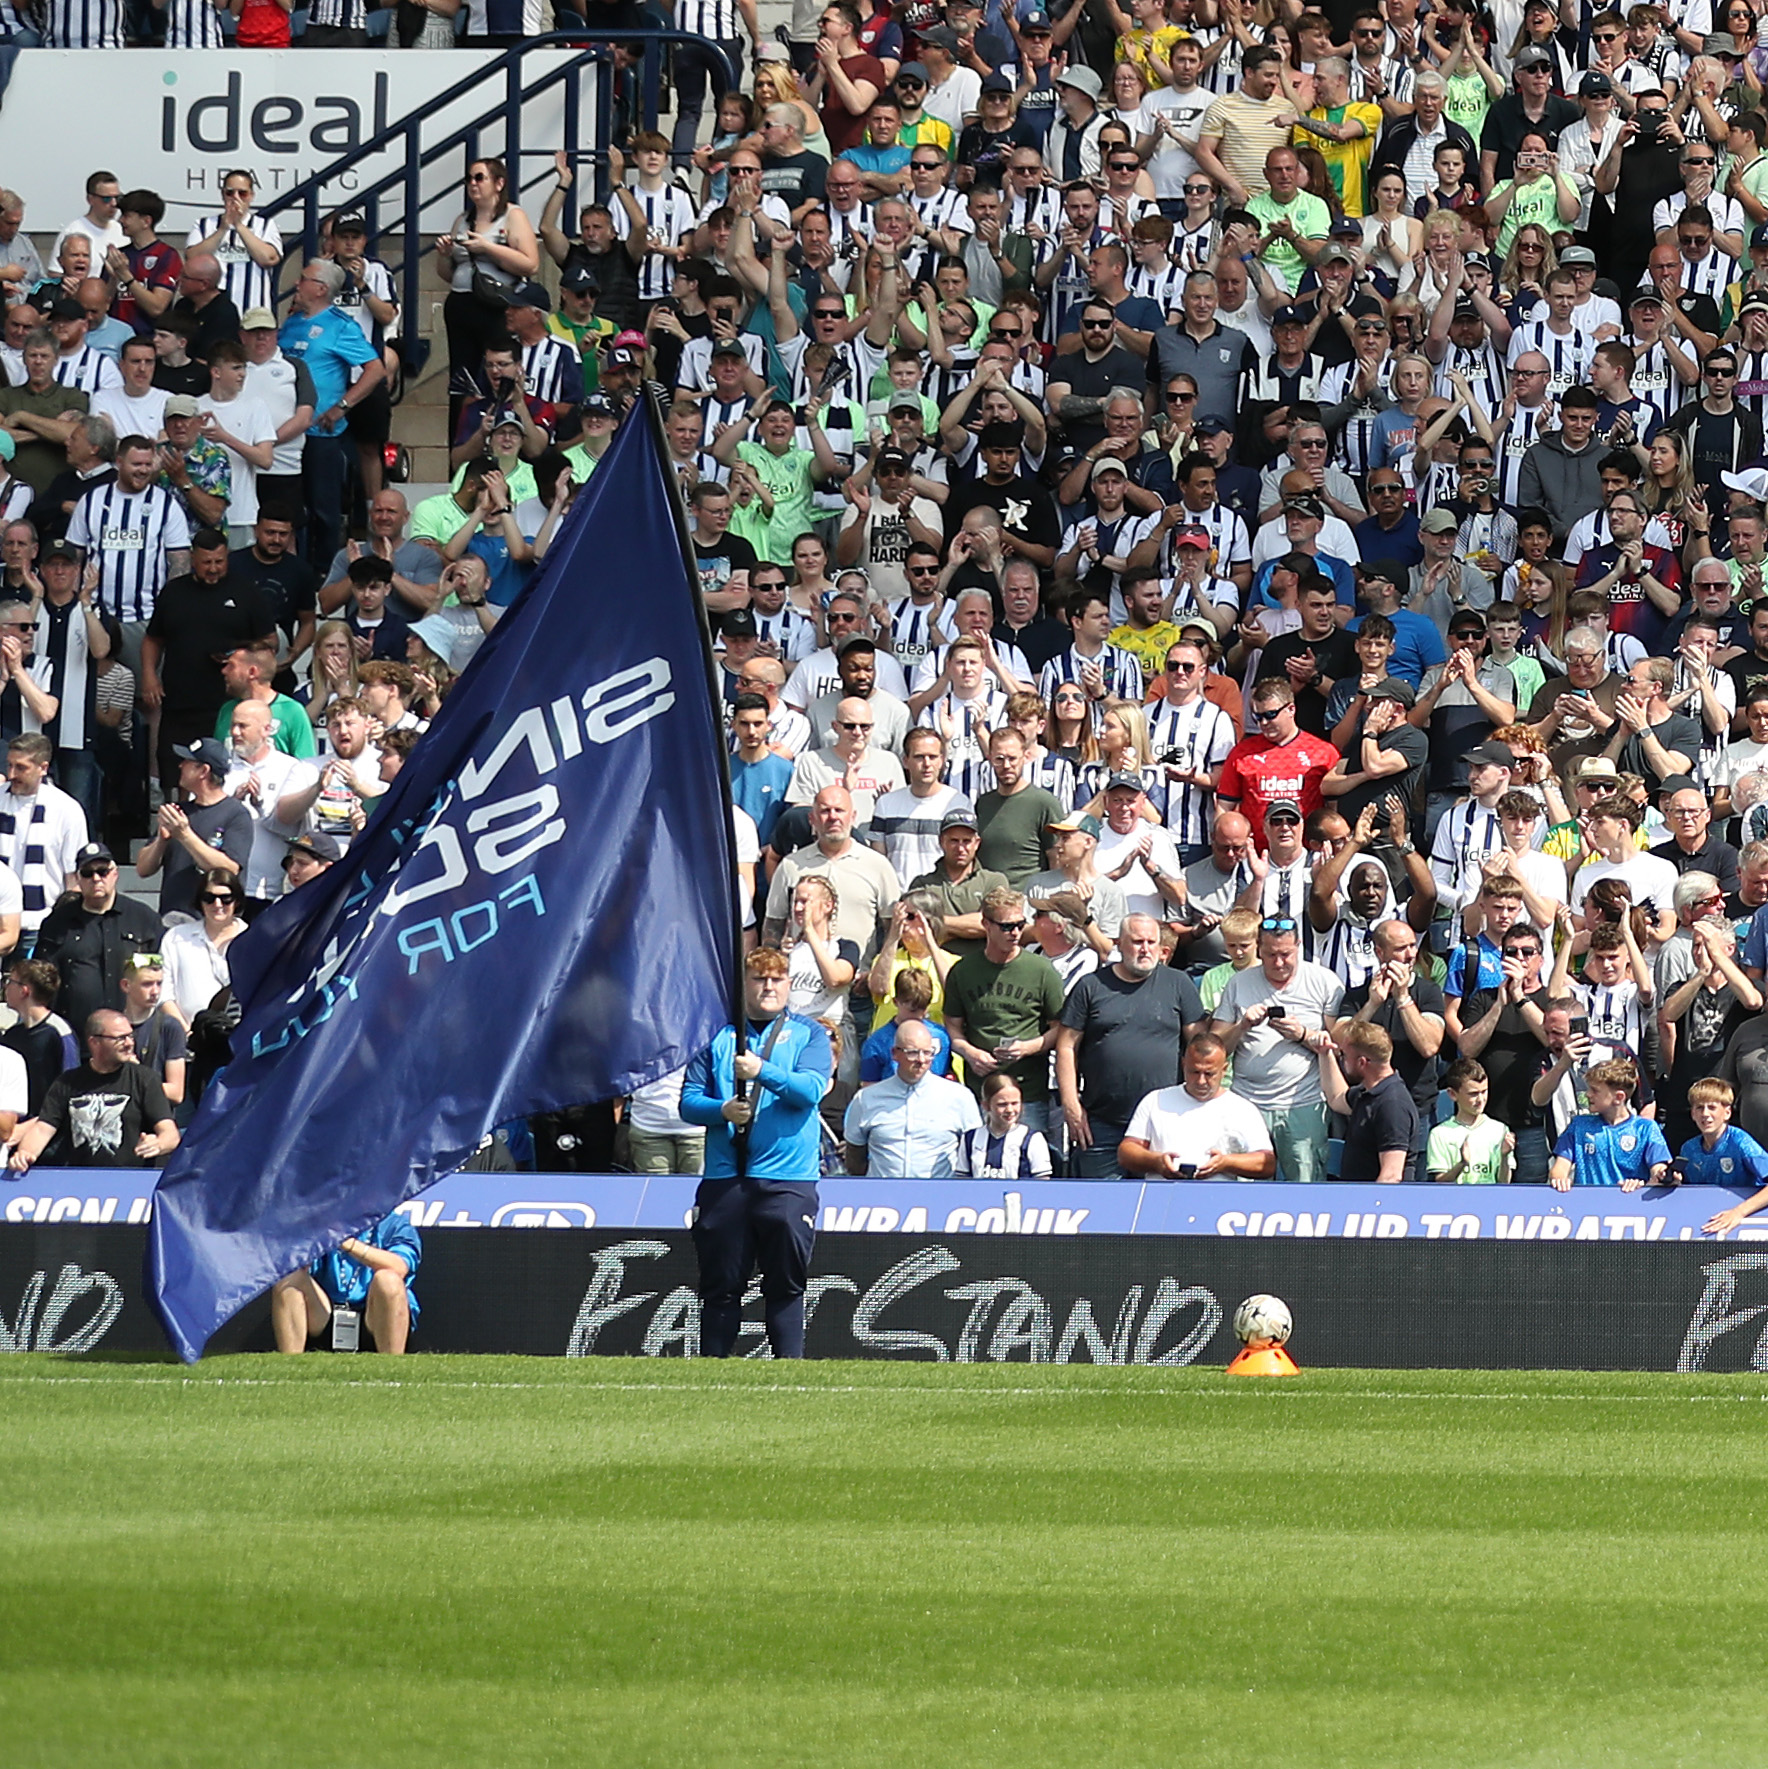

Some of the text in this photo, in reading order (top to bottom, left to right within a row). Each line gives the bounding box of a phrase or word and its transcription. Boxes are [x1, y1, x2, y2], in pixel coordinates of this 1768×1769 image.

[161, 70, 390, 154] ideal
[1448, 99, 1482, 112] ideal
[1509, 202, 1543, 216] ideal
[1634, 368, 1668, 382] ideal
[895, 642, 929, 655] ideal
[1260, 776, 1302, 791] ideal
[853, 1243, 1222, 1366] STAND
